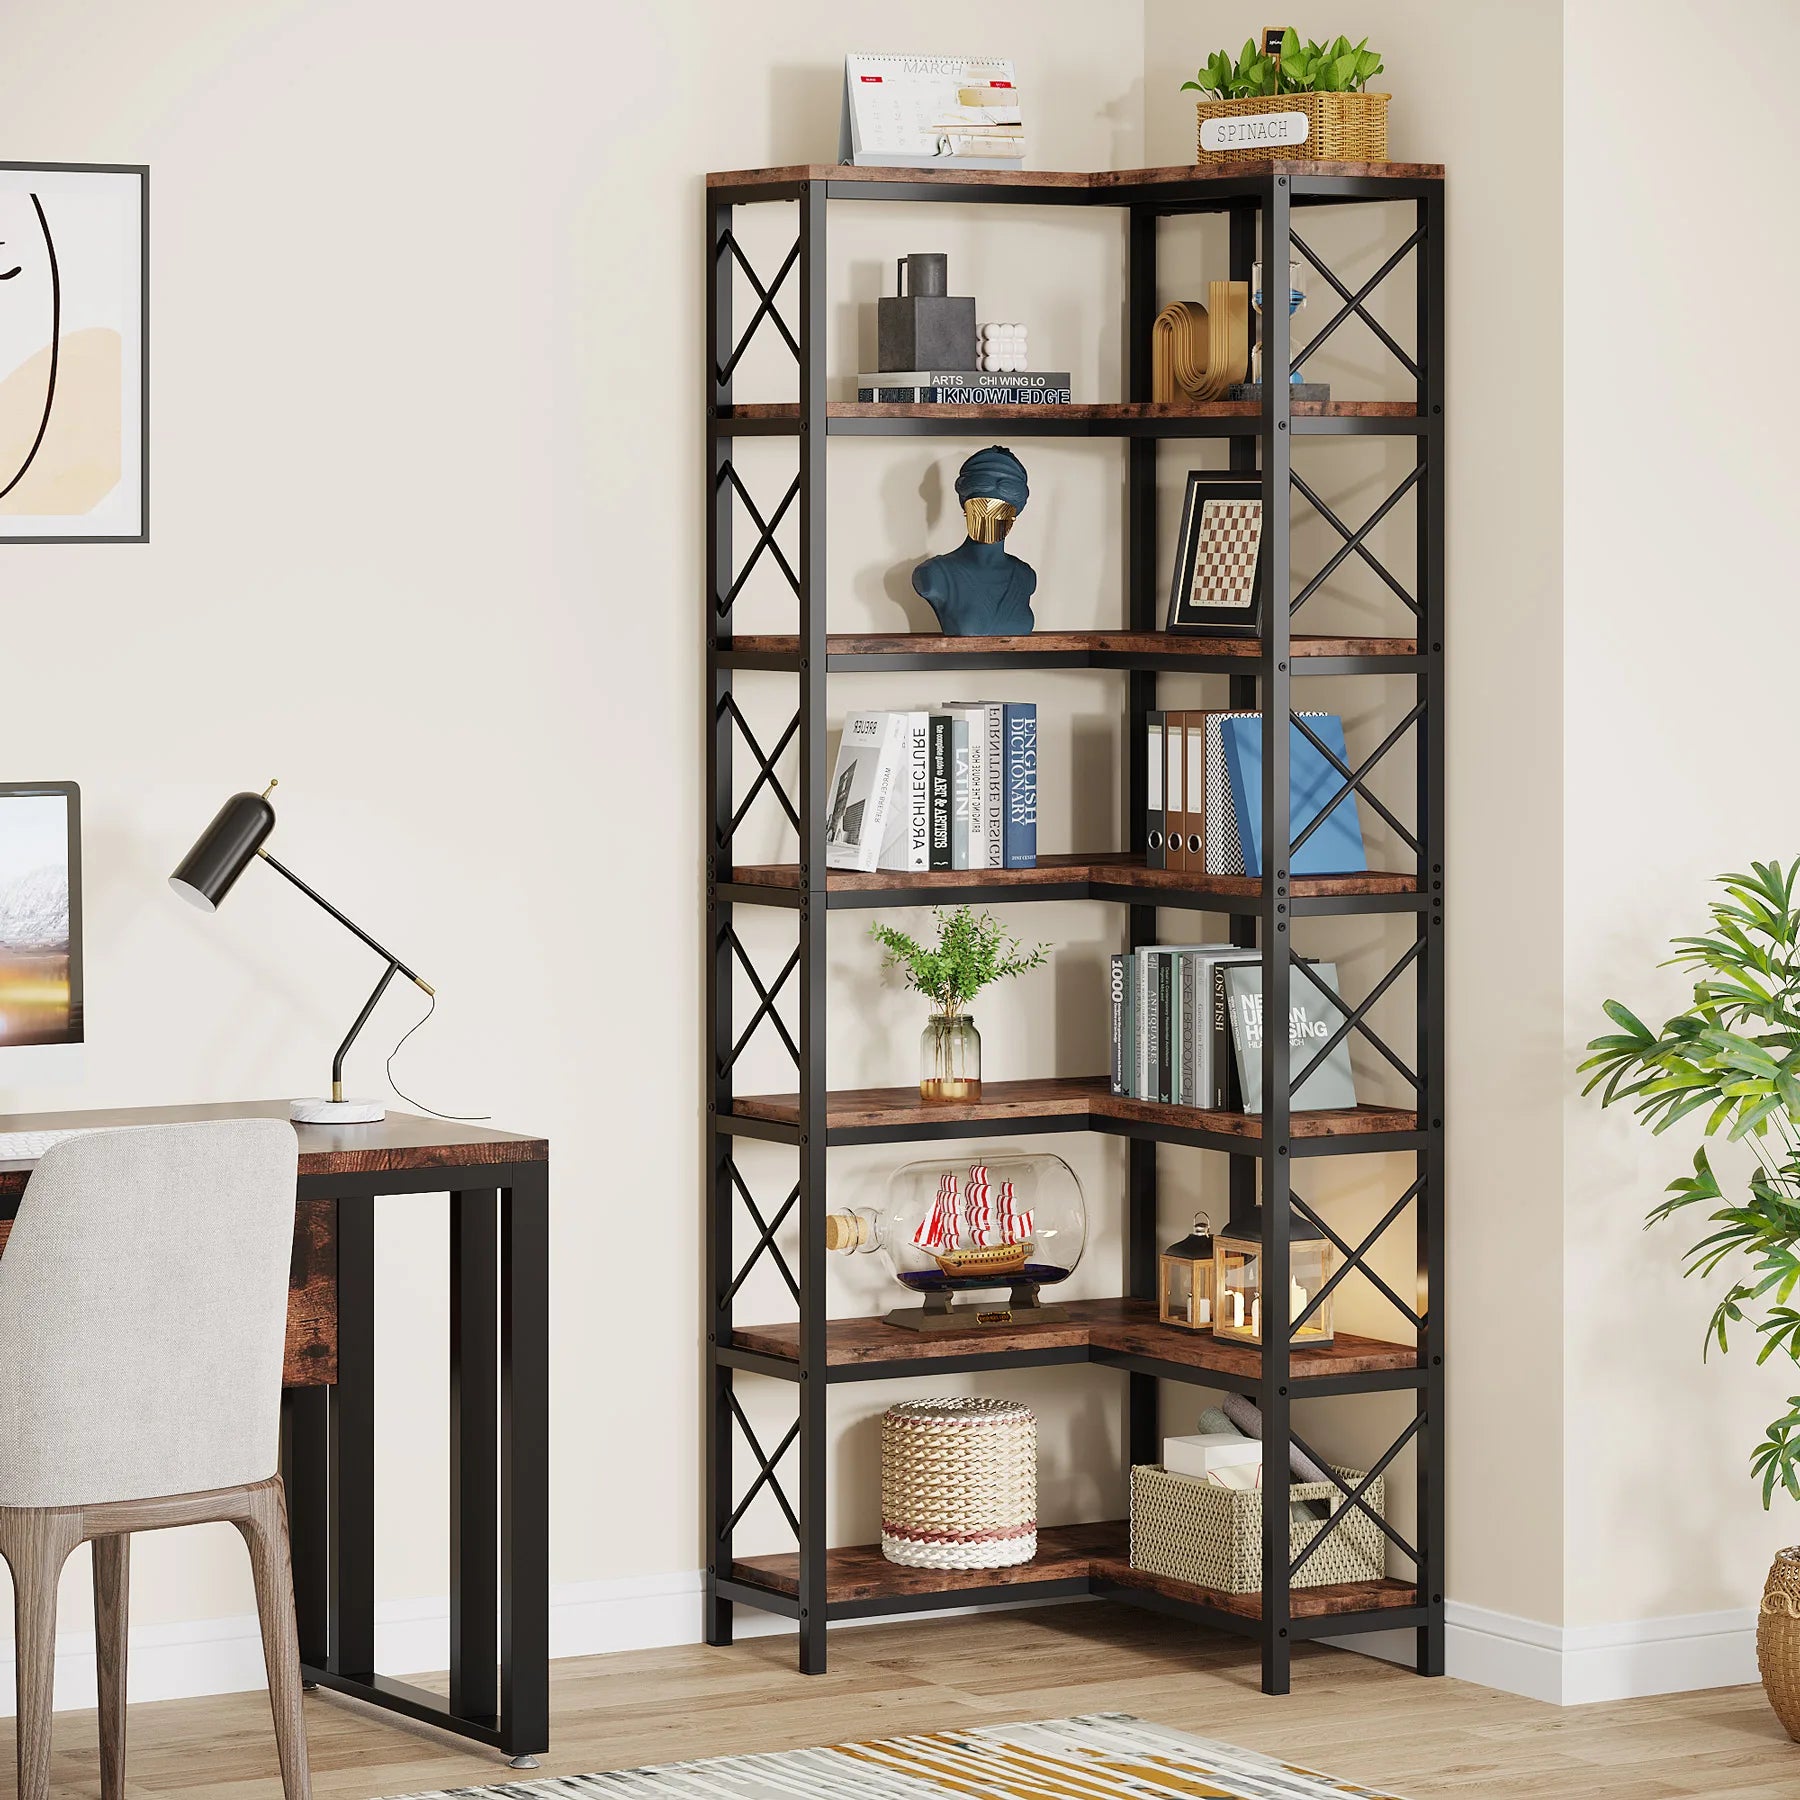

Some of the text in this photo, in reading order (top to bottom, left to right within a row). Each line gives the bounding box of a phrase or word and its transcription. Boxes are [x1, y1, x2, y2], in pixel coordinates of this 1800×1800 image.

[903, 62, 962, 75] MARCH
[1217, 120, 1288, 143] SPINACH
[932, 375, 964, 386] ARTS
[979, 376, 1045, 387] CHI WING LO
[943, 387, 1071, 404] KNOWLEDGE
[1011, 718, 1025, 826] DICTIONARY
[1024, 718, 1036, 825] ENGLISH
[934, 776, 947, 797] ART
[934, 798, 947, 807] &
[934, 807, 947, 849] ARTISTS
[1111, 960, 1123, 1002] 1000
[1183, 956, 1193, 1008] ALEXEY
[1214, 966, 1224, 1031] LOST FISH
[1240, 993, 1263, 1010] NE
